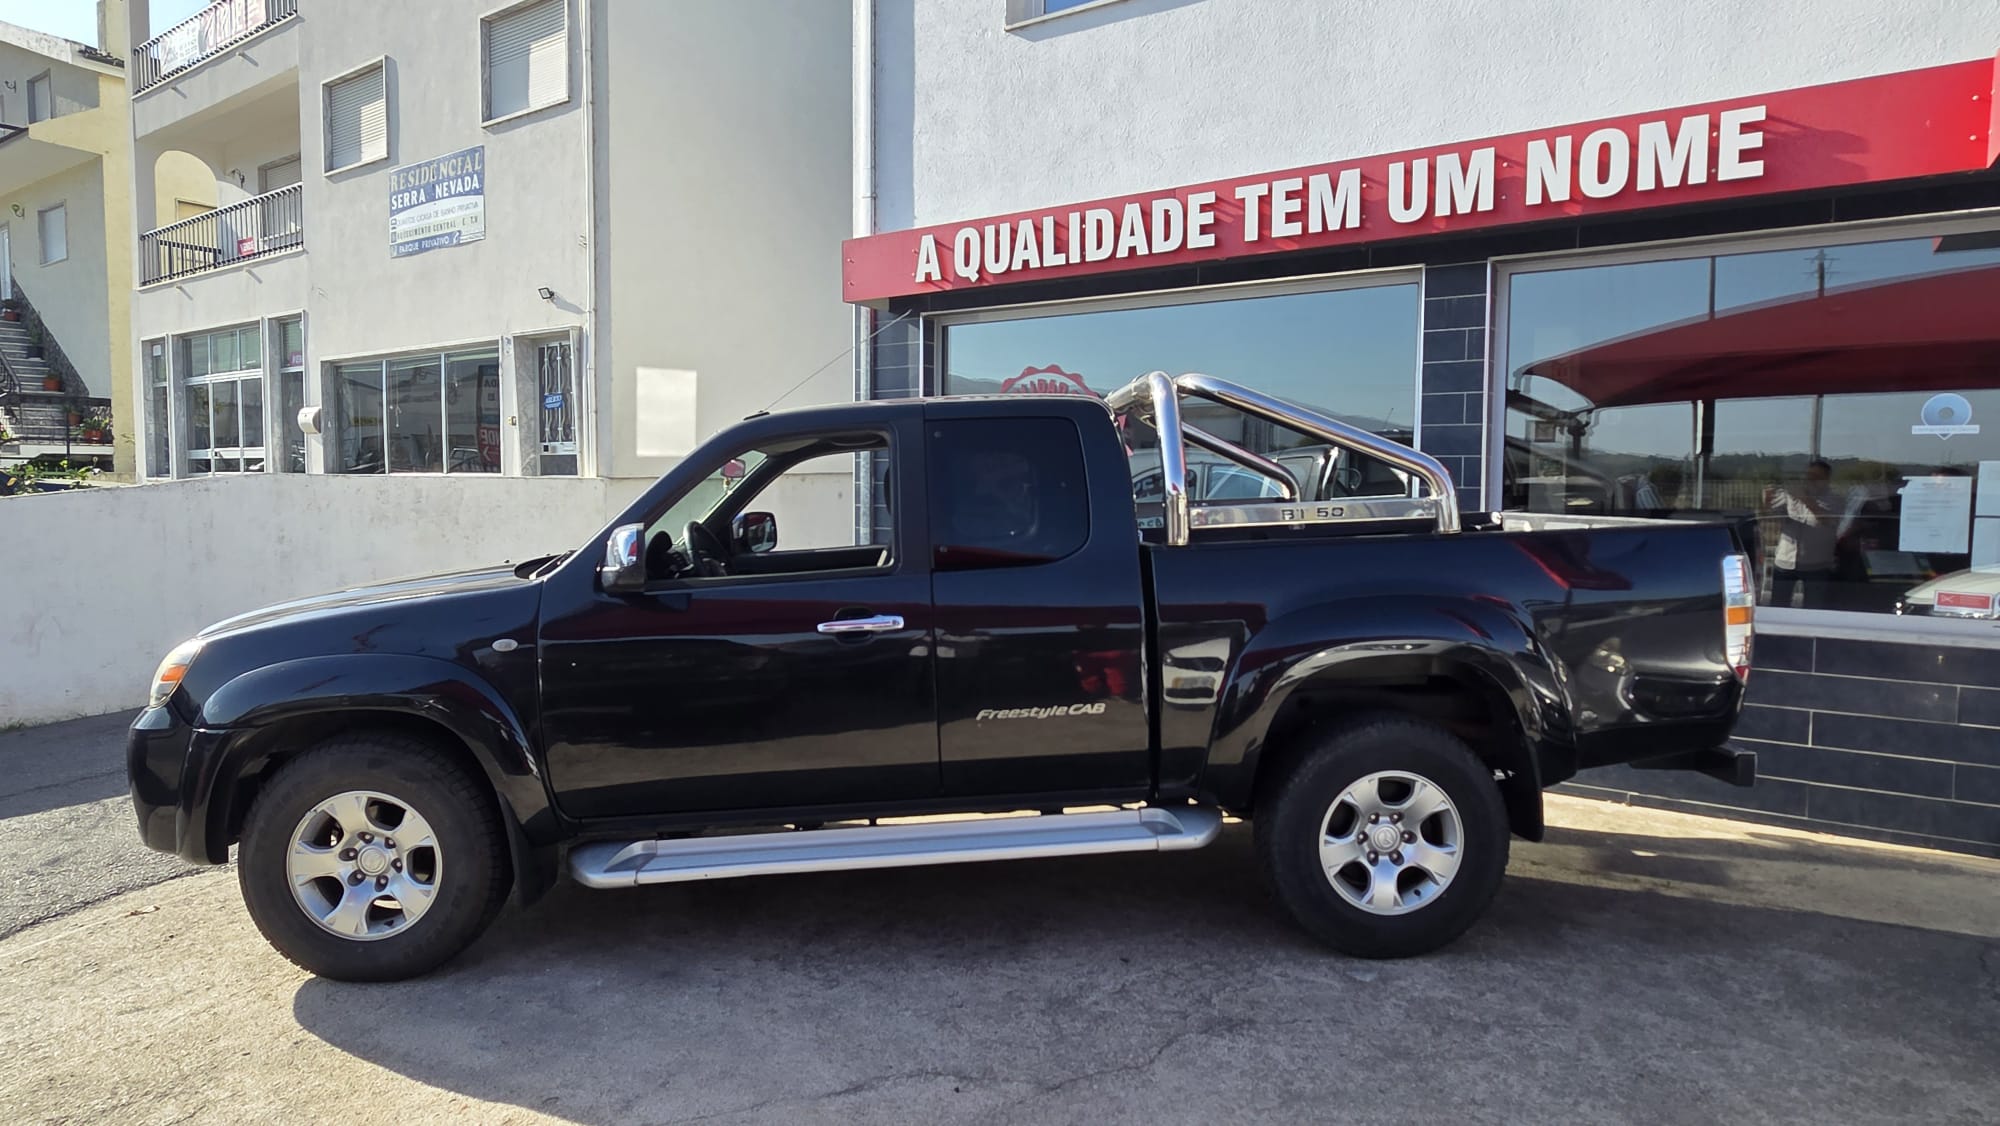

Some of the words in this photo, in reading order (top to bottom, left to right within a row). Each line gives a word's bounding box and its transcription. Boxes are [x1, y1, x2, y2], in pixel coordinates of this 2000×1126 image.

[391, 188, 426, 210] SERRA
[435, 174, 480, 199] NEVADA
[915, 234, 942, 283] A
[953, 190, 1216, 283] QUALIDADE
[1235, 168, 1361, 242] TEM
[1388, 147, 1495, 223] UM
[1525, 105, 1766, 206] NOME
[1316, 507, 1345, 518] 50
